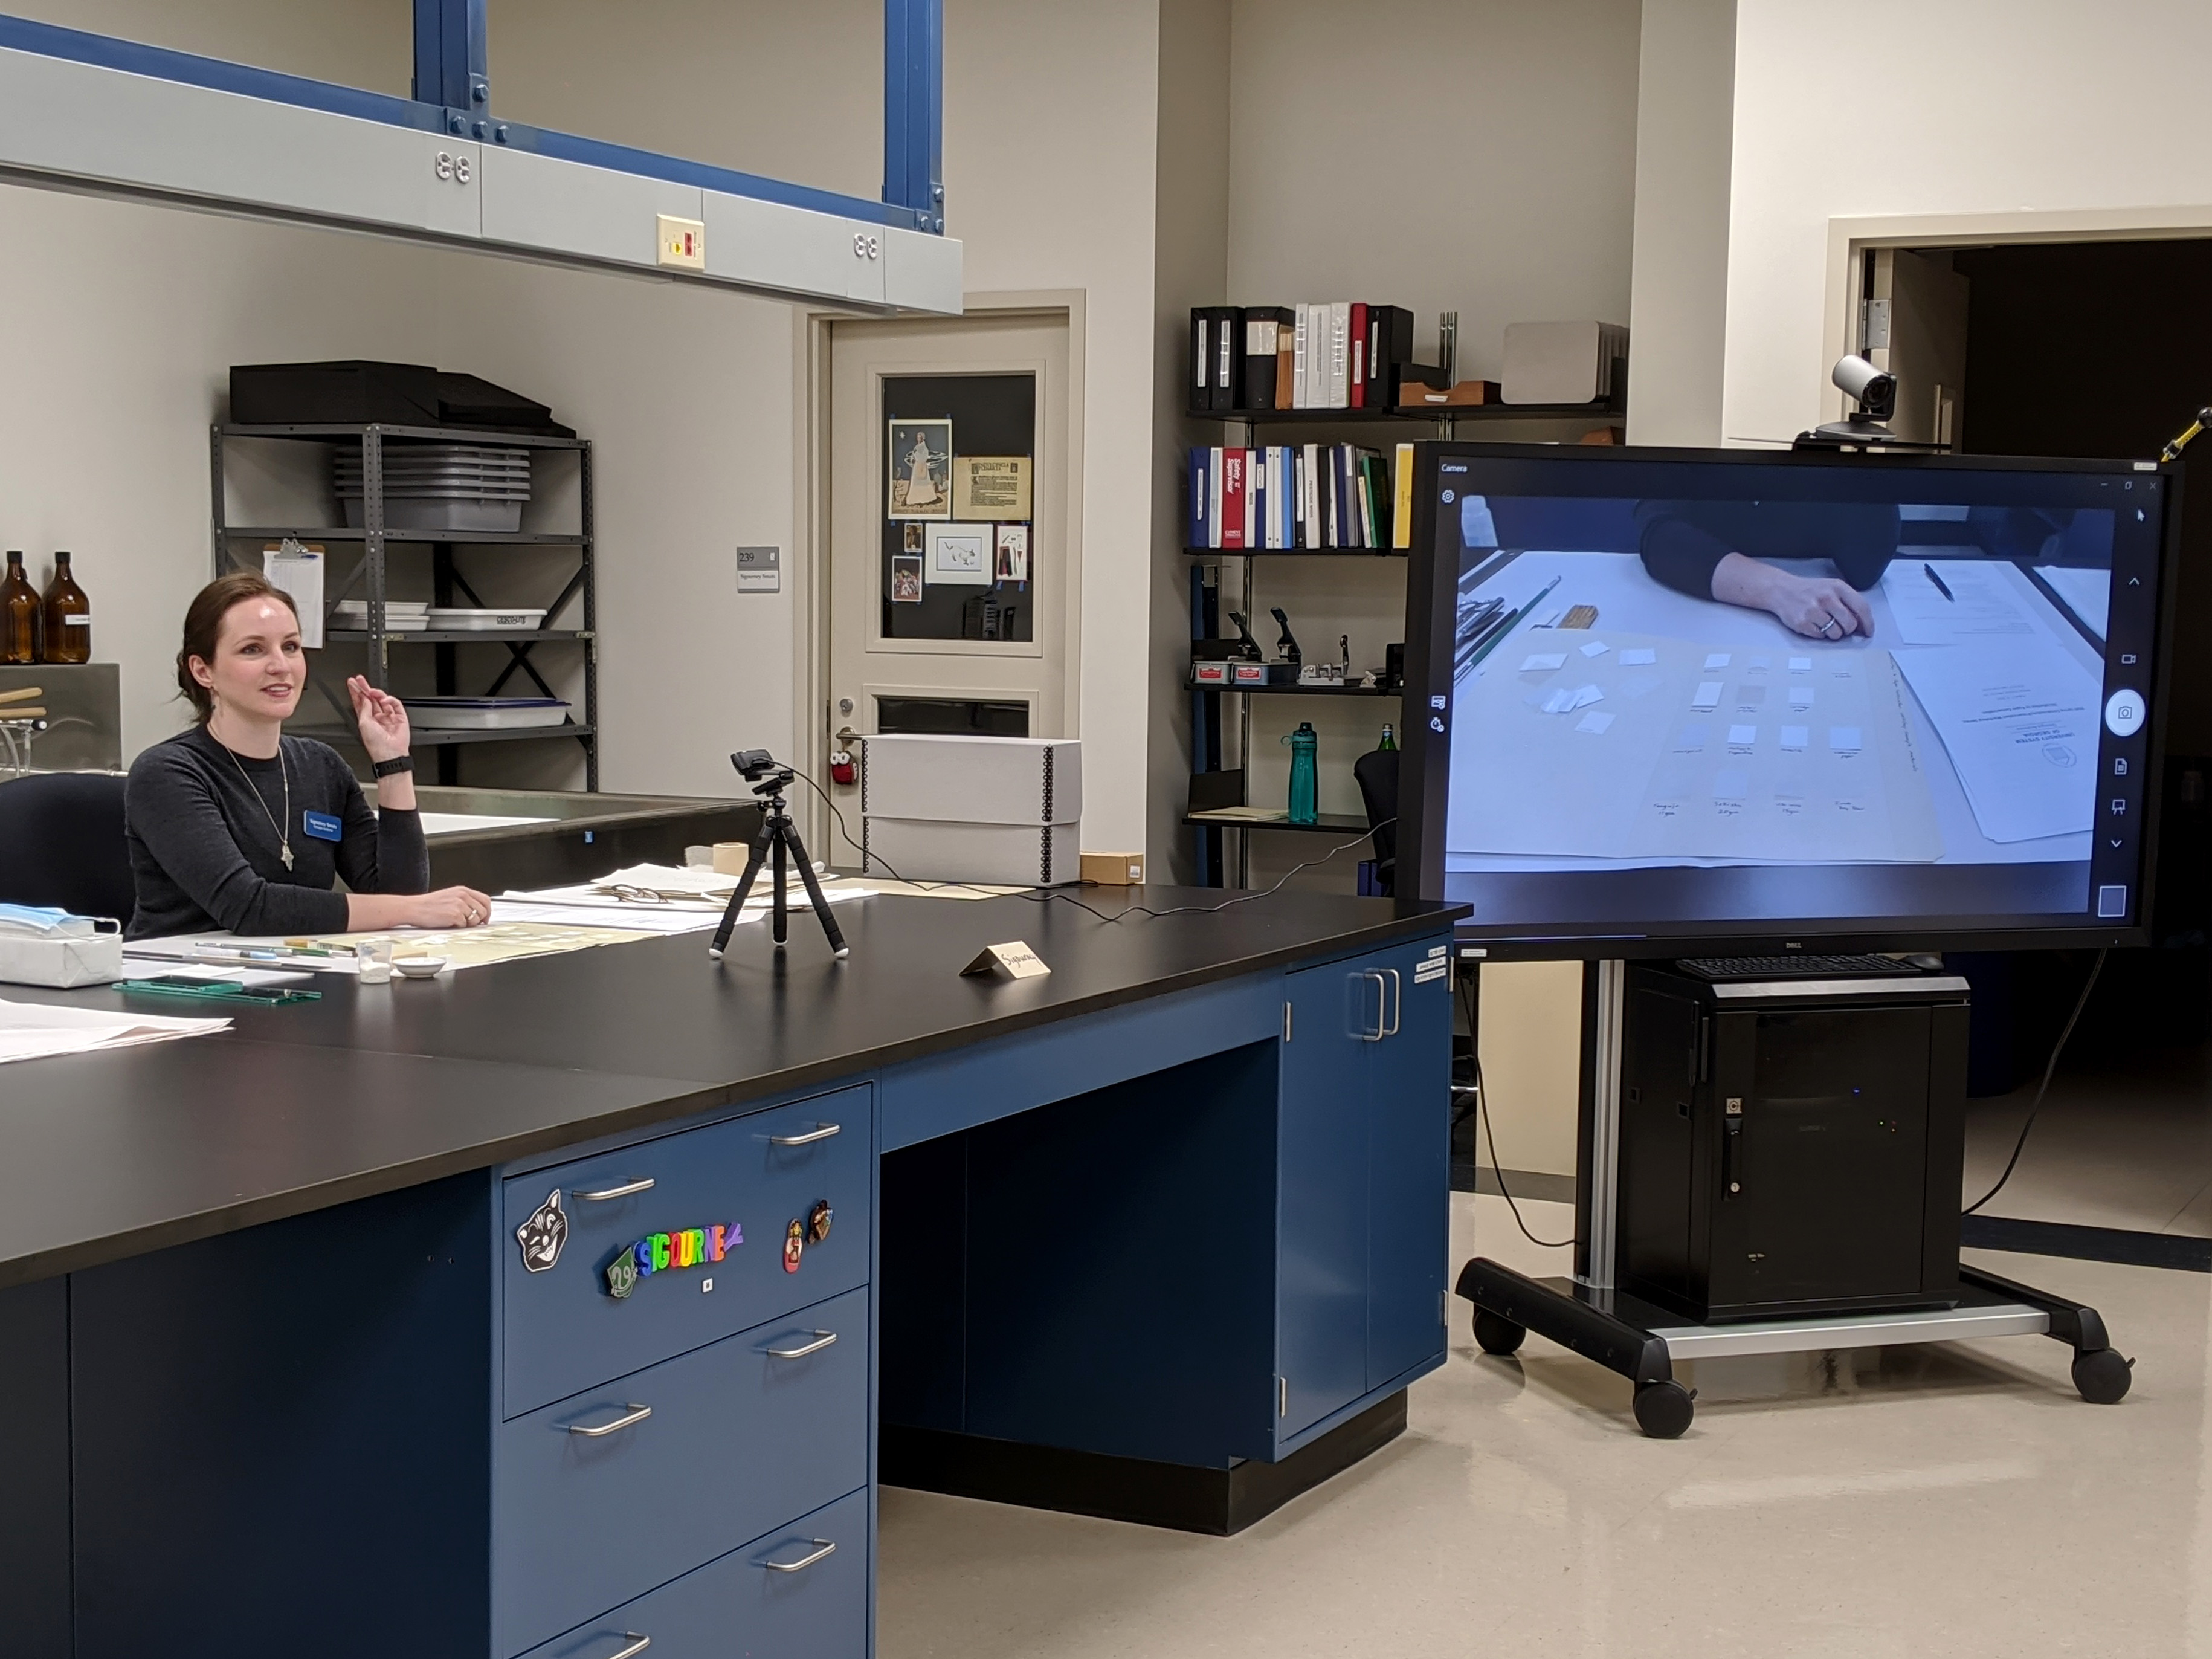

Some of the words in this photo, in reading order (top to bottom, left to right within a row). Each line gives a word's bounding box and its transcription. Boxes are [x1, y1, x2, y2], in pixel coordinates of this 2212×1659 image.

[1441, 464, 1468, 472] Camera
[739, 552, 755, 562] 239
[633, 1221, 744, 1277] SIGOURNEY
